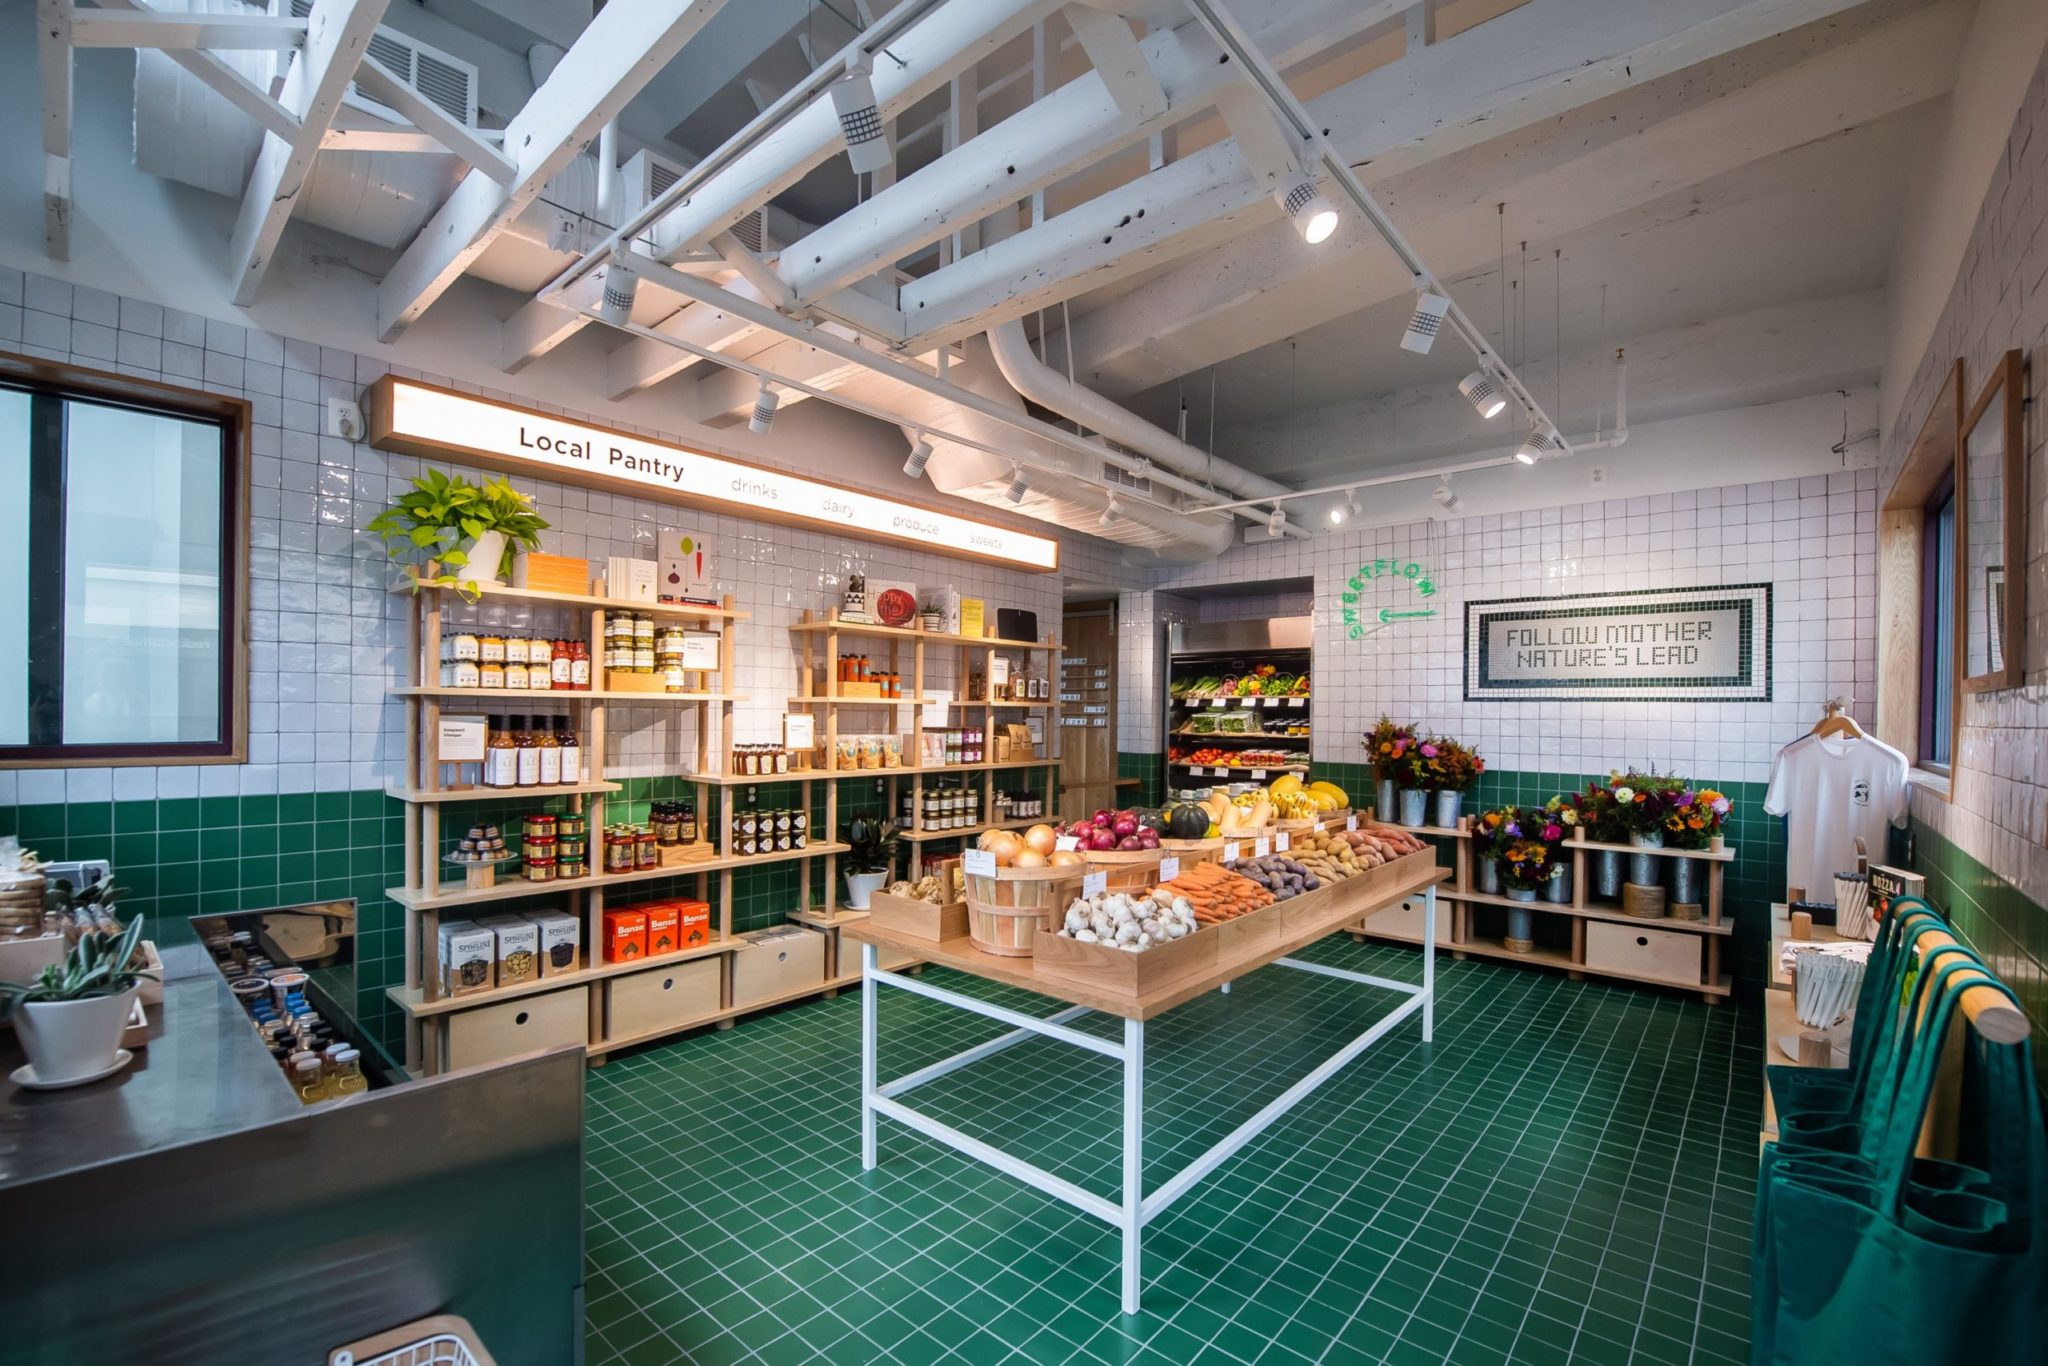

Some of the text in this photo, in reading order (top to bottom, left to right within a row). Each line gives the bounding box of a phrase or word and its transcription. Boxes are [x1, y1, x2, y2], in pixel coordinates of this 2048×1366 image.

[520, 427, 684, 482] Local Pantry
[731, 477, 778, 500] drinks
[822, 498, 855, 519] dairy
[893, 514, 940, 536] produce
[970, 534, 1003, 550] sweets
[866, 588, 903, 605] Happy
[1507, 621, 1712, 647] FOLLOW MOTHER
[1517, 645, 1698, 668] NATURE'S LEAD
[651, 919, 677, 928] Banza
[683, 914, 708, 923] Banza
[617, 925, 645, 935] Banza
